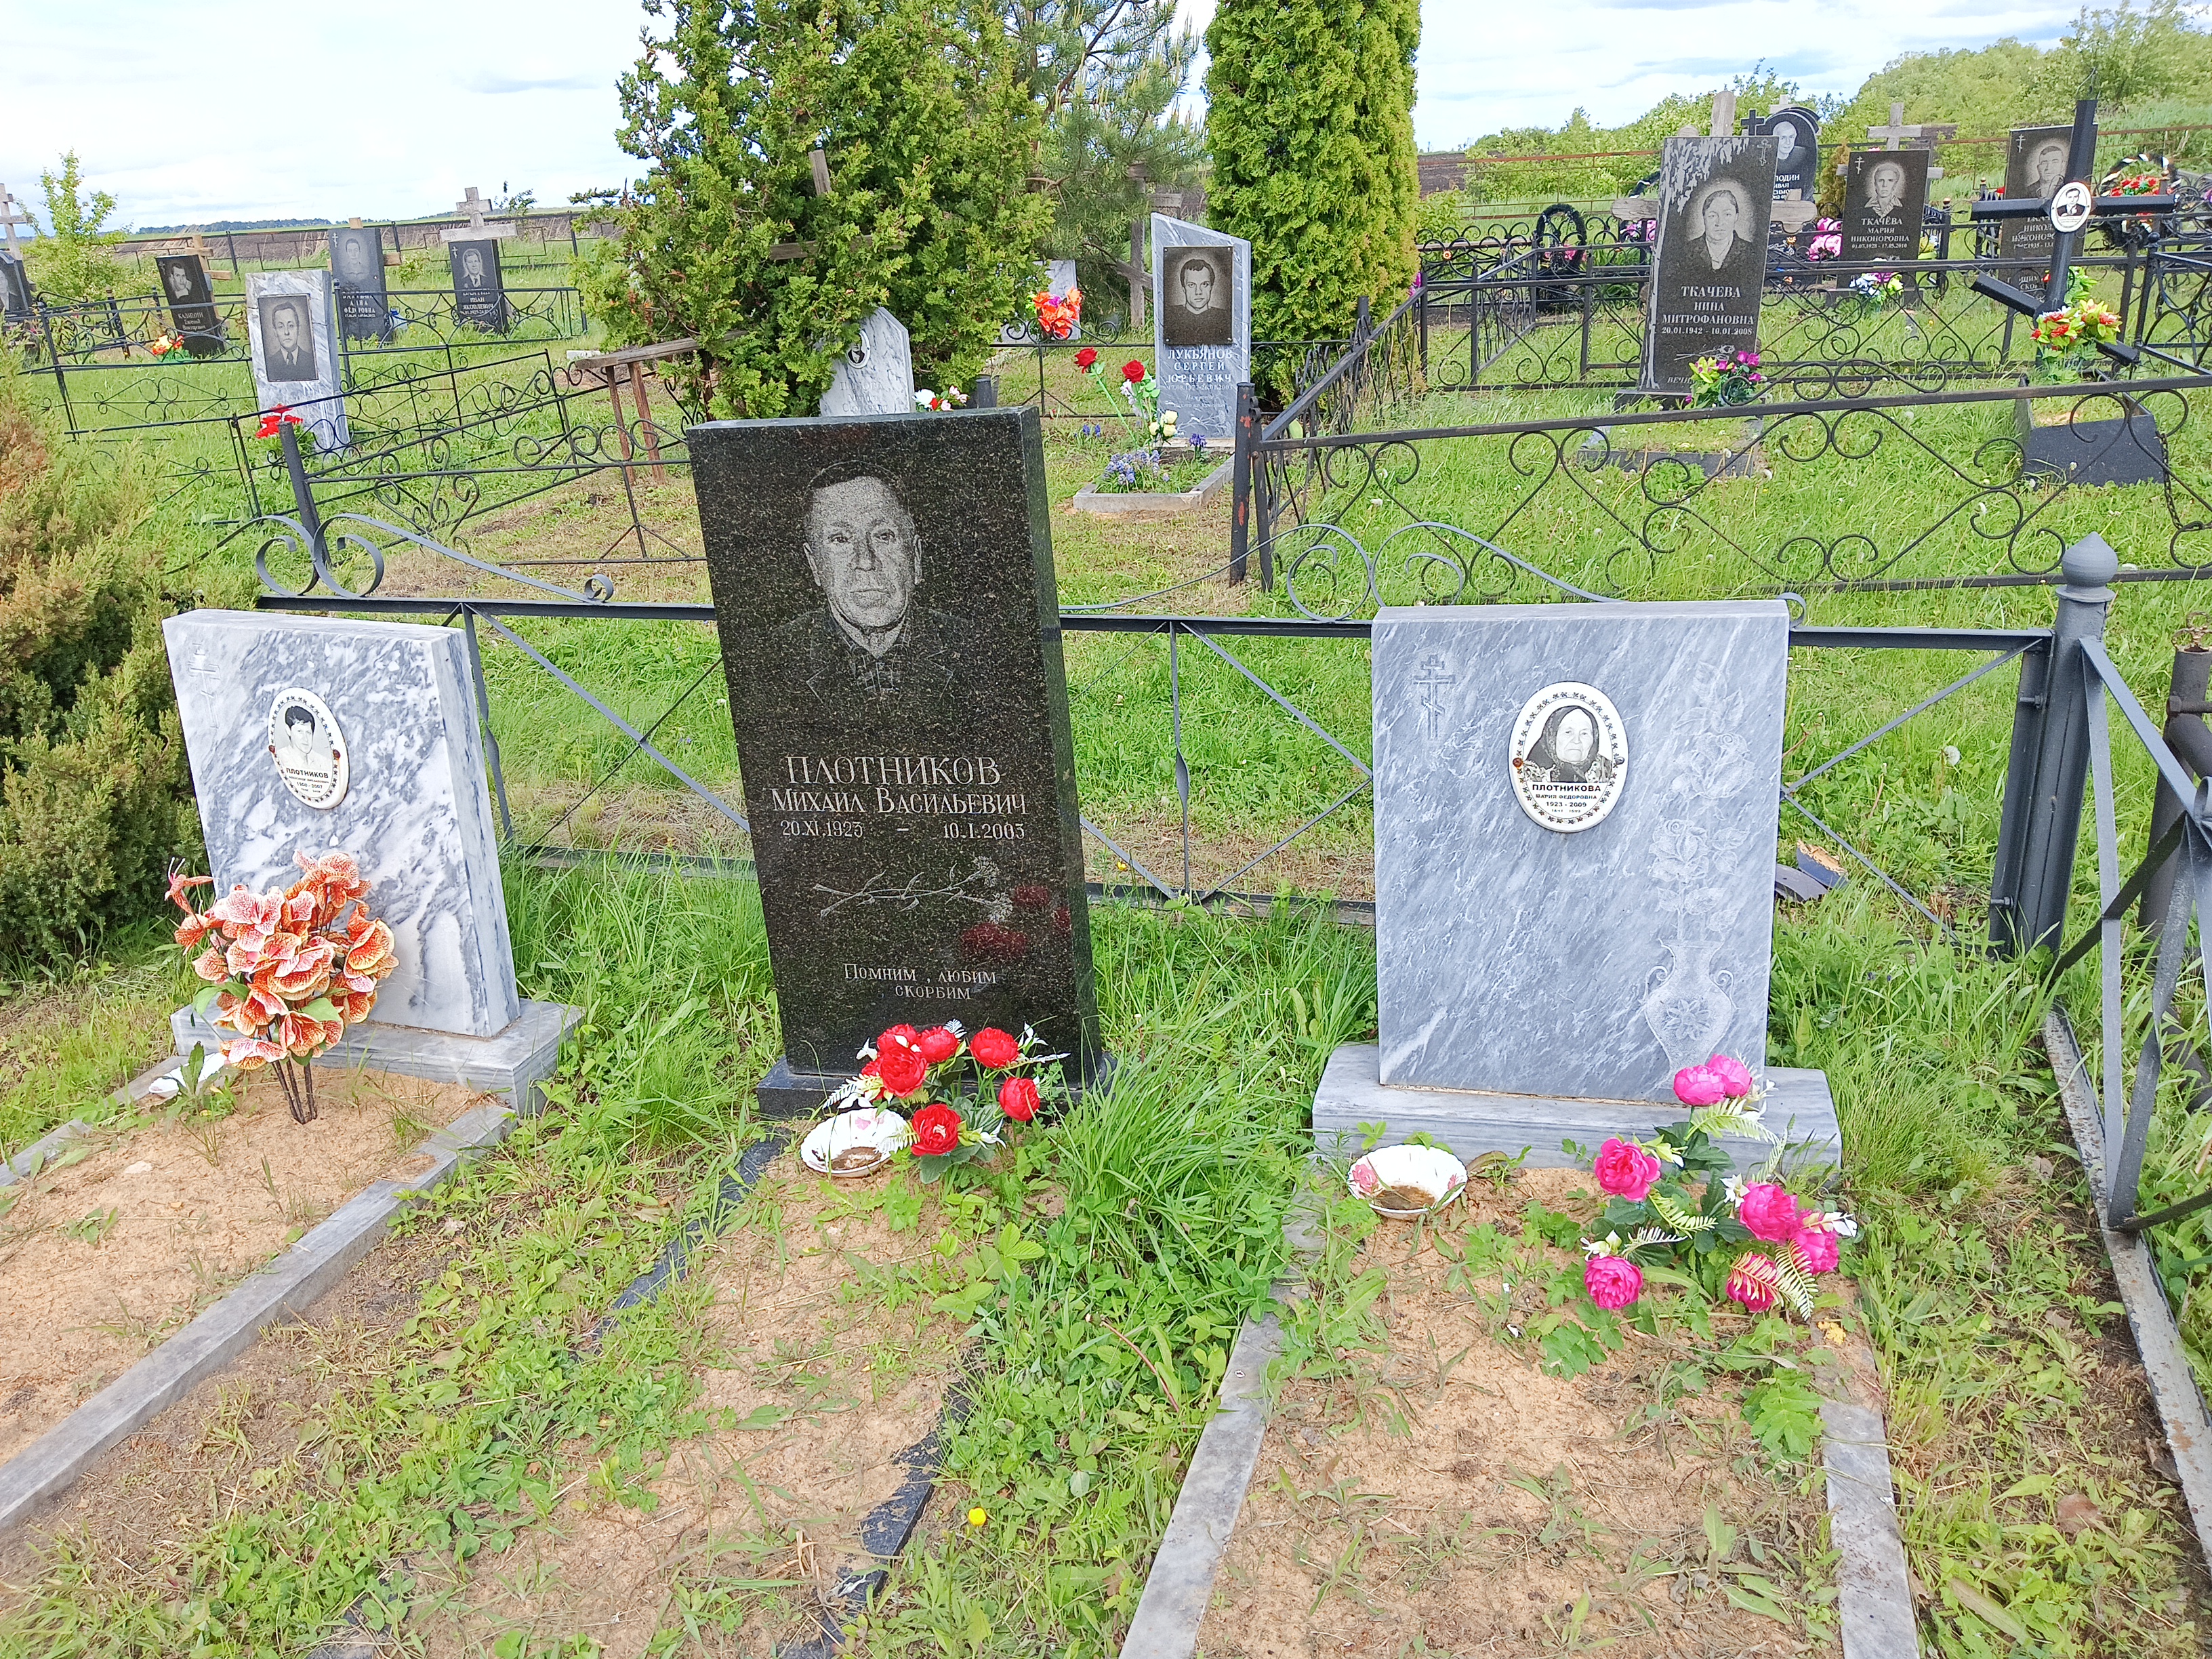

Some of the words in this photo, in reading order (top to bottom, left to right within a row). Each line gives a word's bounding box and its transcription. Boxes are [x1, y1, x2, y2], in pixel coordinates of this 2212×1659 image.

[1861, 216, 1903, 226] ТКАЧЁВА
[1681, 286, 1740, 298] ТКАЧЕВА
[1694, 302, 1725, 311] НИНА
[1662, 314, 1754, 325] МИТРОФАНОВНА
[1174, 360, 1225, 371] СЕРГЕЙ
[1166, 374, 1231, 383] ЮРЬЕВИЧ
[286, 767, 329, 778] ПЛОТНИКОВ
[785, 756, 1001, 785] ПЛОТНИКОВ
